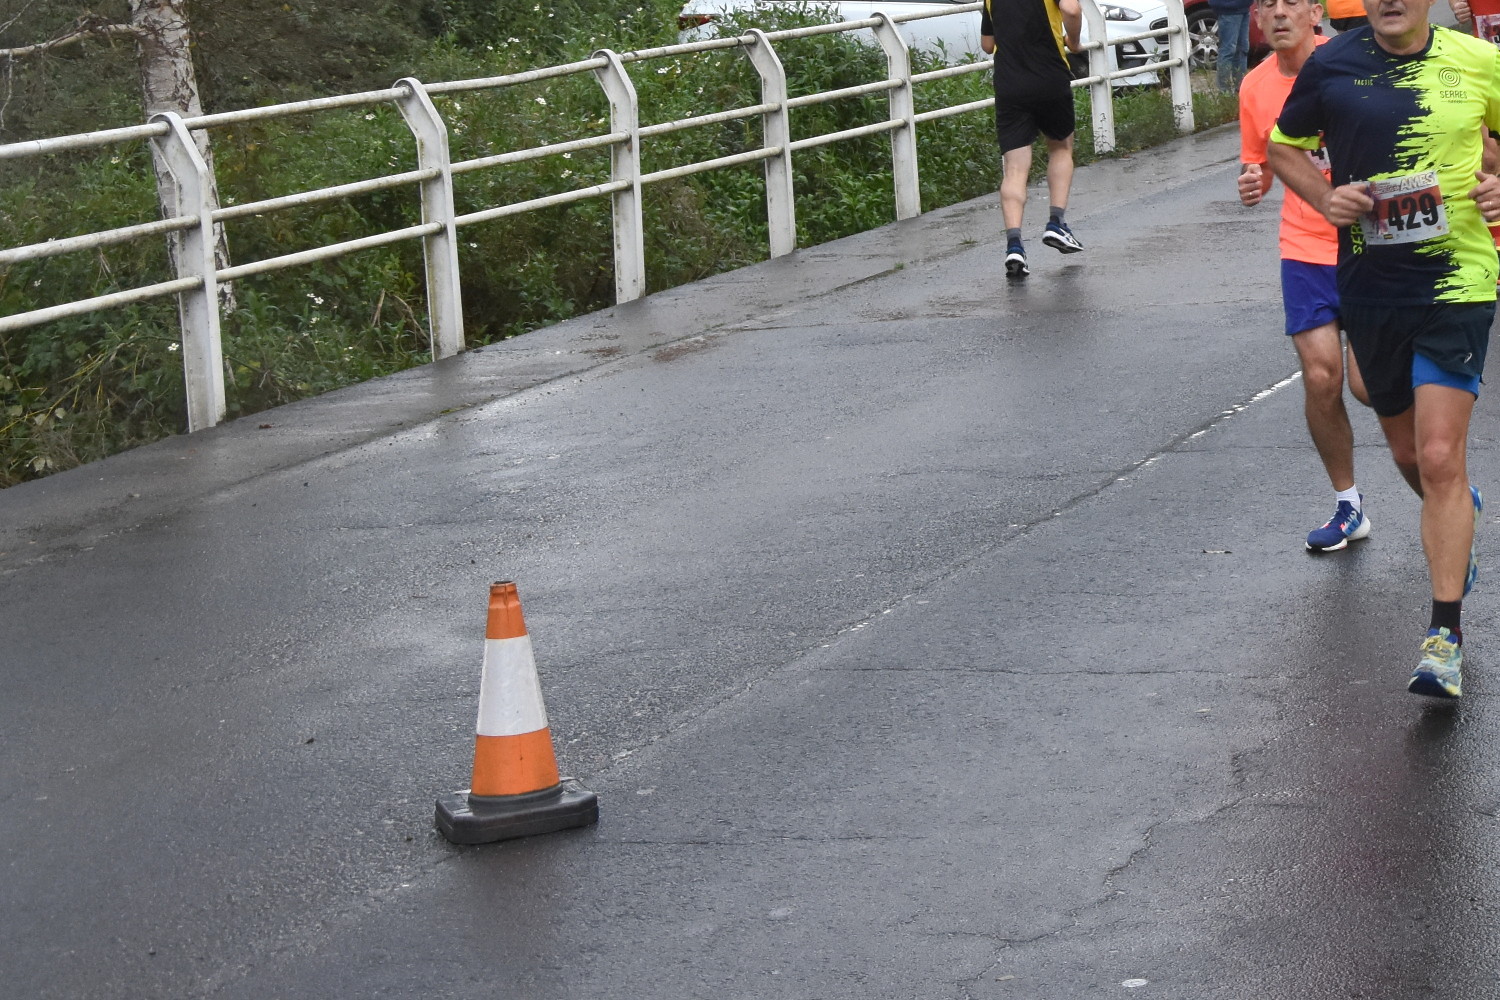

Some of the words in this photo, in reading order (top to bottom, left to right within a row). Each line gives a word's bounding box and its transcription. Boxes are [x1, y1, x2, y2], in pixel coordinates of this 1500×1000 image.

[1440, 90, 1468, 99] SERRES
[1401, 172, 1434, 191] AMES
[1388, 193, 1439, 231] 429
